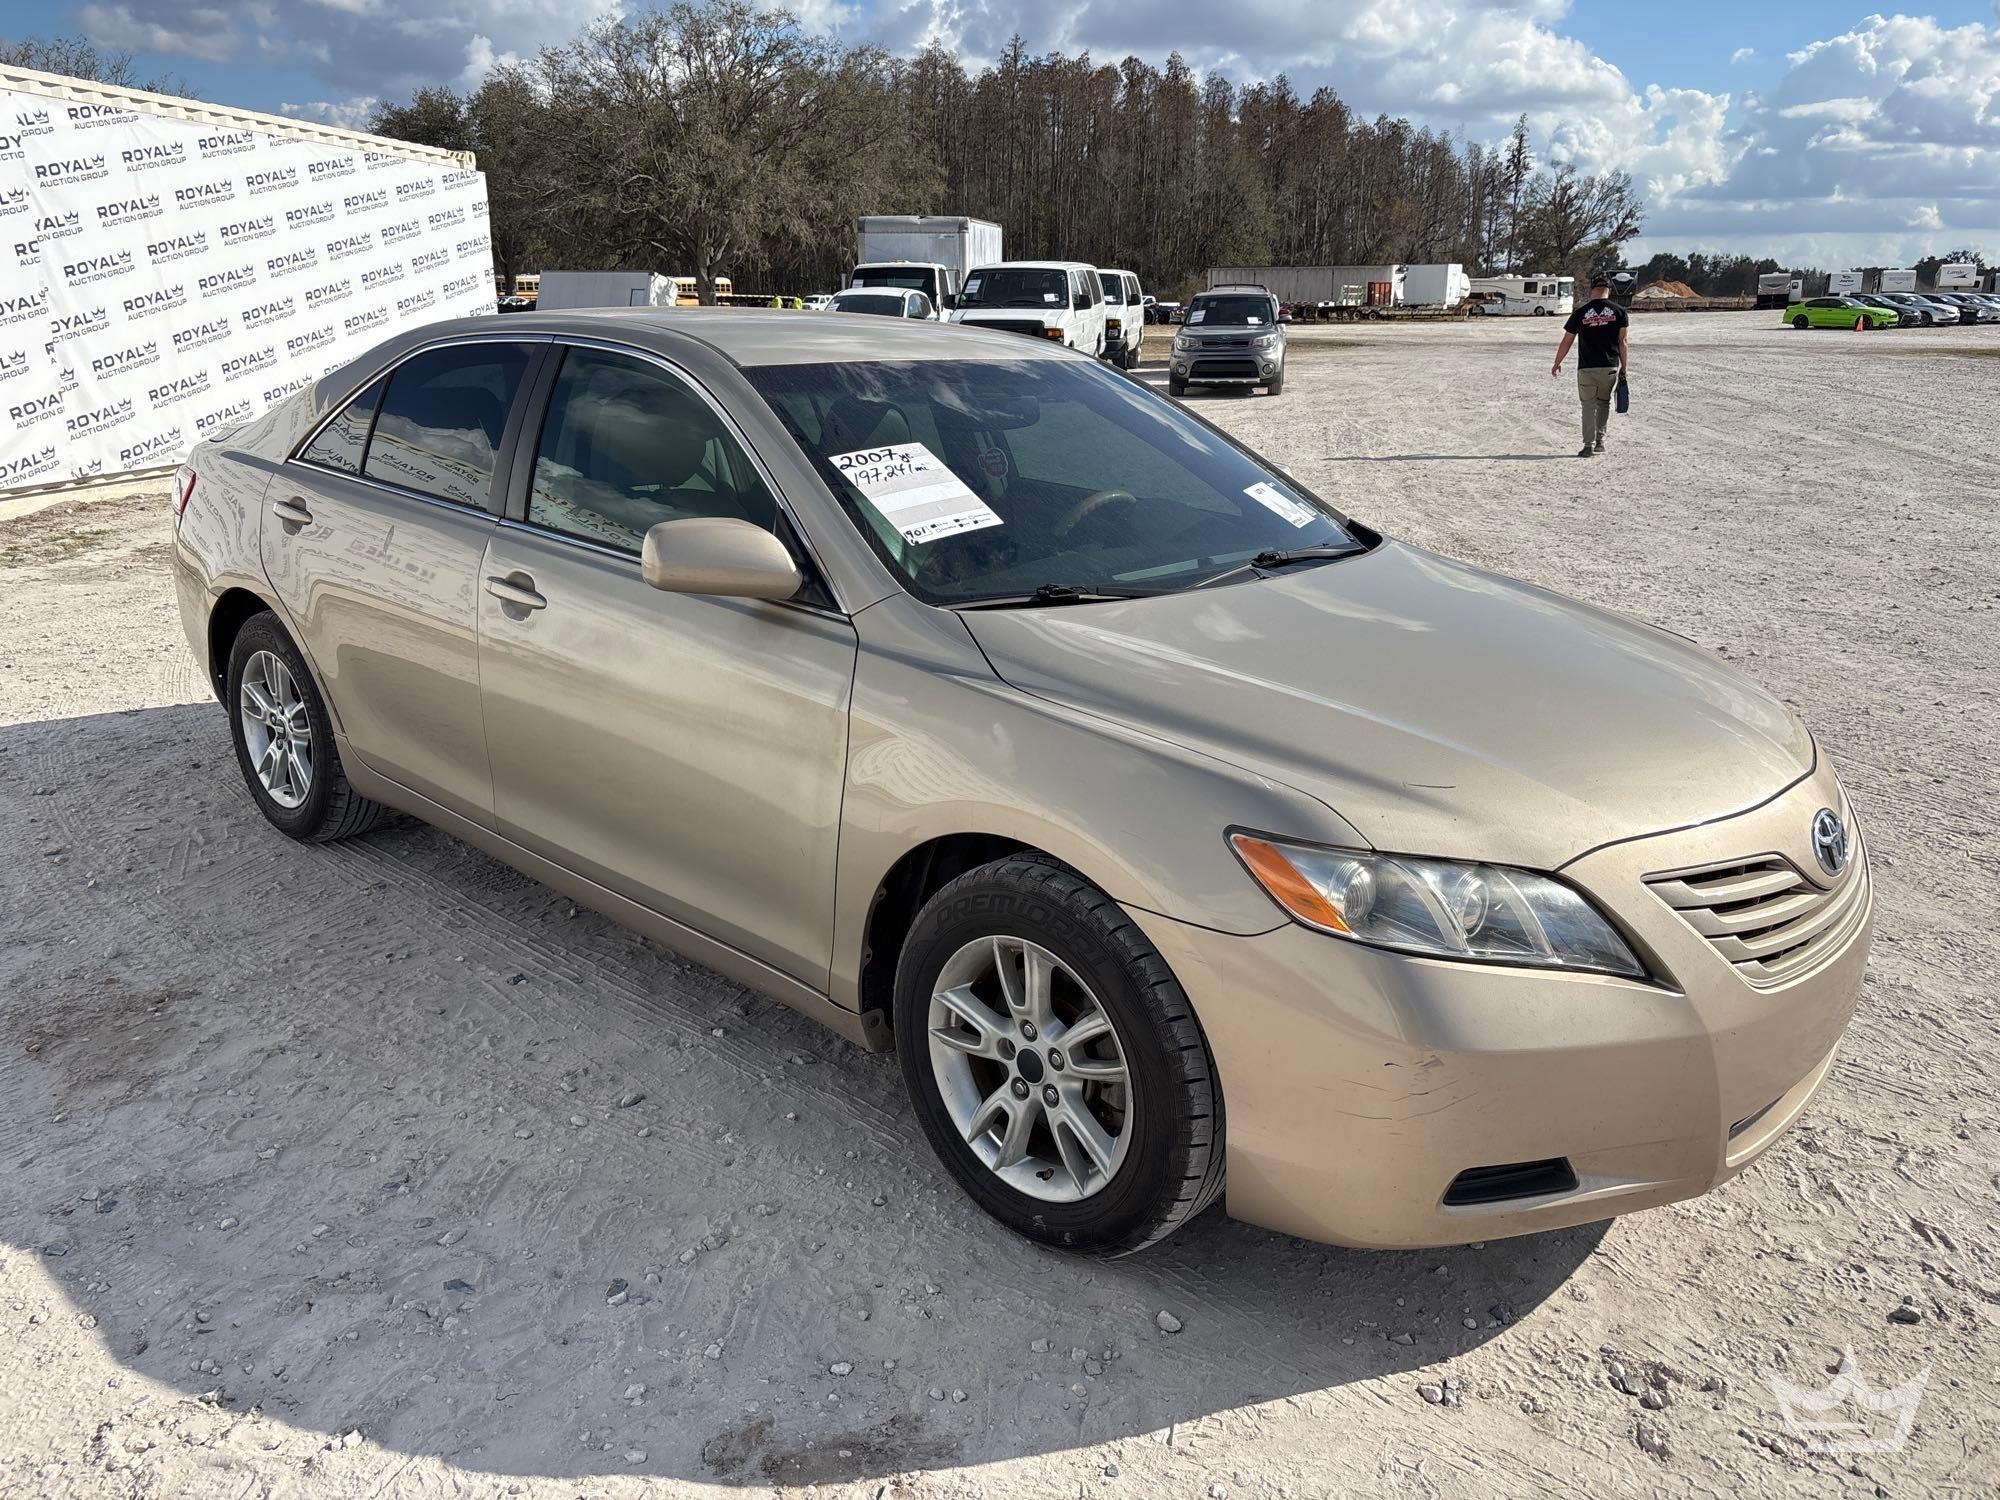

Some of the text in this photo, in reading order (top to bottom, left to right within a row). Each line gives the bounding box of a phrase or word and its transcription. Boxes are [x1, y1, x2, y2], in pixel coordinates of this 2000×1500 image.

[74, 115, 139, 130] AUCTION GROUP
[21, 127, 54, 137] GROUP
[198, 134, 242, 150] ROYAL
[0, 151, 25, 161] CTIO
[122, 145, 171, 163] ROYAL
[202, 145, 255, 159] AUCTION GROUP
[35, 158, 93, 178] ROYAL
[127, 156, 186, 173] AUCTION GROUP
[308, 158, 345, 174] ROYAL
[40, 170, 109, 188] AUCTION GROUP
[246, 170, 286, 187] ROYAL
[312, 169, 356, 182] AUCTION GROUP
[442, 171, 470, 184] ROYAL
[175, 183, 221, 201] ROYAL
[250, 180, 299, 196] AUCTION GROUP
[396, 181, 426, 195] ROYAL
[399, 189, 435, 203] AUCTION GROUP
[96, 198, 148, 219] ROYAL
[180, 193, 235, 210] AUCTION GROUP
[344, 191, 379, 208] ROYAL
[346, 201, 388, 215] AUCTION GROUP
[102, 209, 164, 228] AUCTION GROUP
[286, 204, 324, 222] ROYAL
[289, 214, 335, 230] AUCTION GROUP
[429, 210, 457, 224] ROYAL
[35, 216, 65, 231] YAL
[220, 219, 264, 238] ROYAL
[381, 223, 412, 238] ROYAL
[52, 227, 83, 239] GROUP
[224, 229, 276, 246] AUCTION GROUP
[384, 231, 421, 246] AUCTION GROUP
[147, 236, 195, 256] ROYAL
[327, 236, 362, 253] ROYAL
[330, 245, 373, 261] AUCTION GROUP
[457, 238, 482, 253] ROYAL
[152, 245, 209, 265] AUCTION GROUP
[267, 252, 306, 270] ROYAL
[412, 252, 441, 268] ROYAL
[64, 255, 119, 277] ROYAL
[271, 260, 318, 278] AUCTION GROUP
[361, 266, 394, 283] ROYAL
[69, 265, 135, 288] AUCTION GROUP
[199, 269, 243, 290] ROYAL
[365, 274, 404, 291] AUCTION GROUP
[443, 277, 470, 293] ROYAL
[203, 278, 256, 298] AUCTION GROUP
[306, 283, 342, 301] ROYAL
[124, 290, 172, 312] ROYAL
[128, 298, 187, 321] AUCTION GROUP
[309, 291, 352, 310] AUCTION GROUP
[397, 293, 427, 310] ROYAL
[470, 302, 494, 317] ROYAL
[242, 302, 284, 324] ROYAL
[246, 309, 296, 330] AUCTION GROUP
[345, 311, 379, 329] ROYAL
[51, 313, 93, 334] OYAL
[347, 317, 389, 336] AUCTION GROUP
[53, 322, 110, 344] CTION GROUP
[172, 323, 217, 345] ROYAL
[287, 330, 325, 350] ROYAL
[177, 331, 232, 354] AUCTION GROUP
[291, 337, 336, 358] AUCTION GROUP
[92, 347, 144, 372] ROYAL
[96, 355, 160, 381] AUCTION GROUP
[222, 352, 264, 374] ROYAL
[225, 359, 277, 382] AUCTION GROUP
[149, 376, 197, 401] ROYAL
[153, 384, 211, 410] AUCTION GROUP
[264, 380, 303, 402] ROYAL
[16, 410, 56, 430] AUCTION
[66, 405, 119, 432] ROYAL
[70, 412, 136, 441] AUCTION GROUP
[196, 405, 240, 430] ROYAL
[120, 434, 170, 461] ROYAL
[123, 441, 184, 470] AUCTION GROUP
[0, 454, 42, 478] OYAL
[840, 448, 897, 470] 2007
[28, 460, 60, 477] GROUP
[854, 464, 912, 486] 197,241
